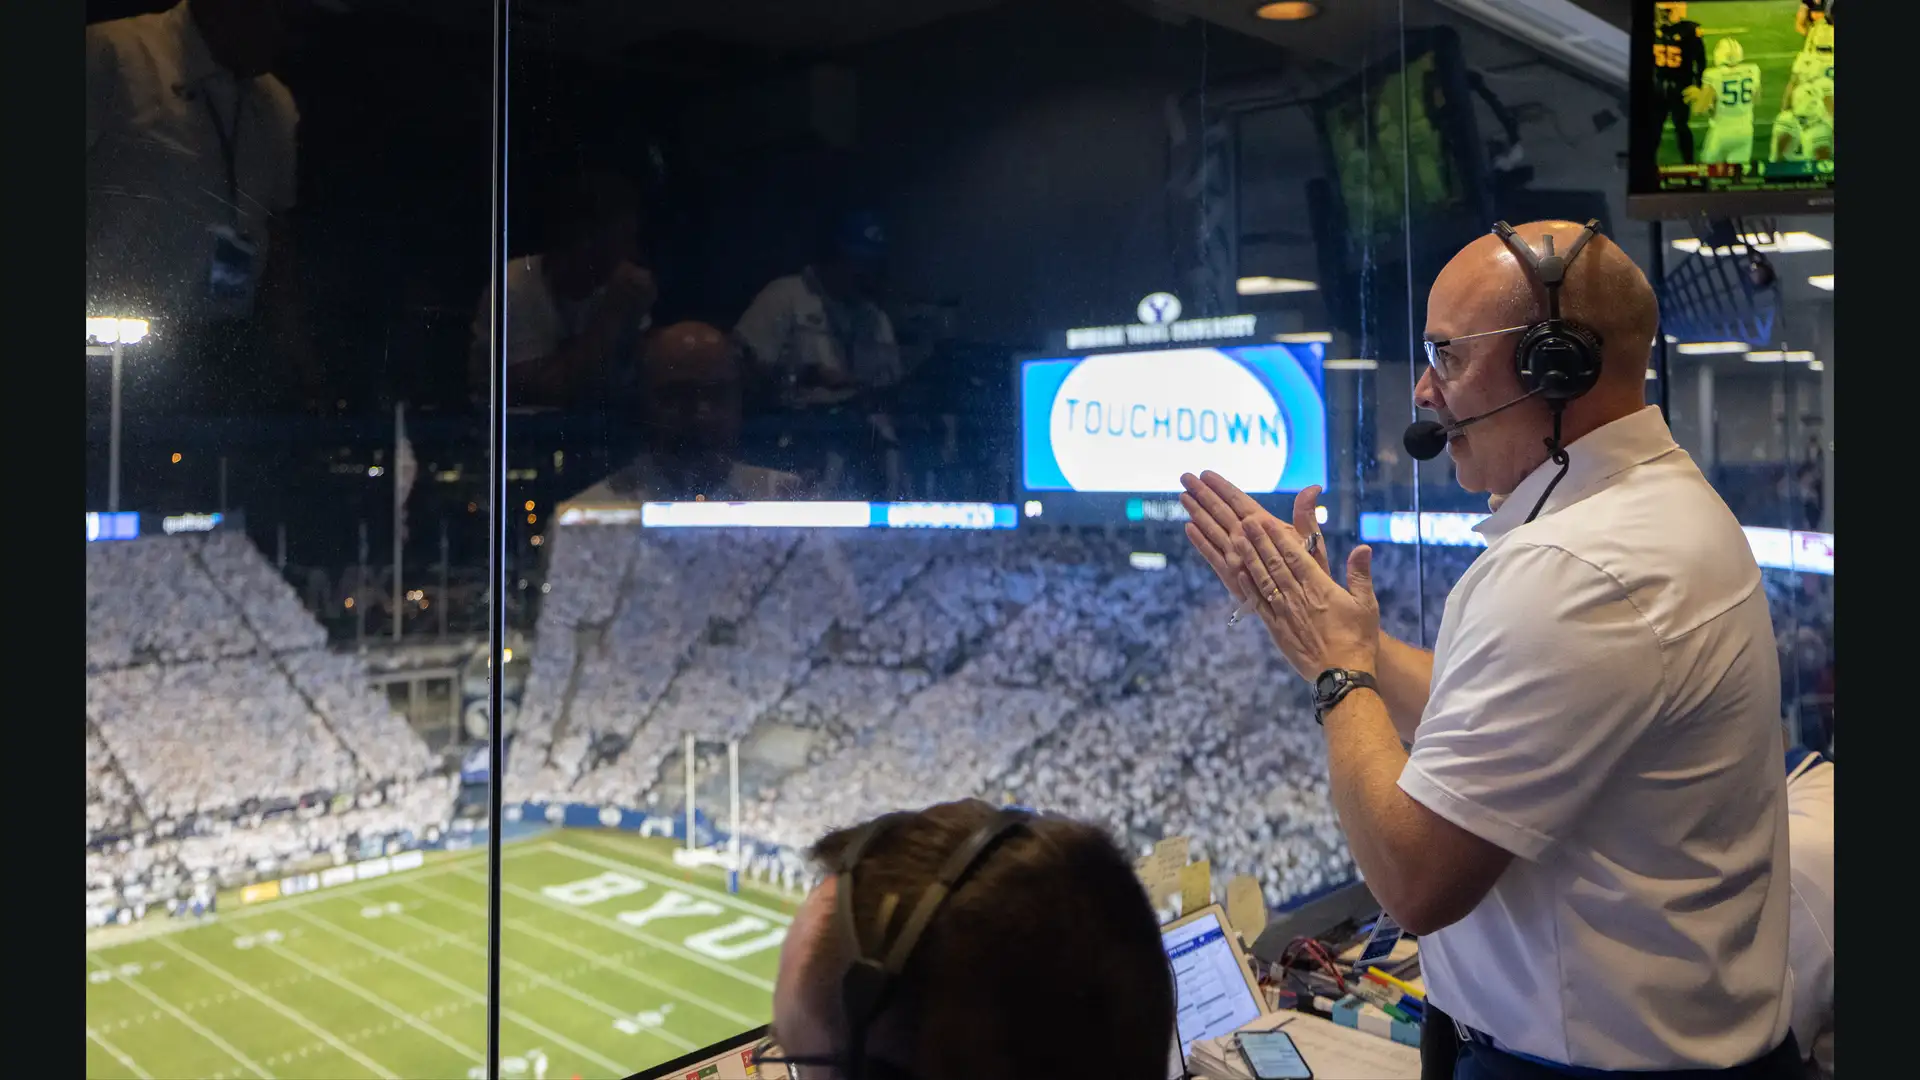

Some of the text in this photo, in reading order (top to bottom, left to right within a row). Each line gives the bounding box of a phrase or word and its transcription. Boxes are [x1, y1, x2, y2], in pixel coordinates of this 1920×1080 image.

[1722, 78, 1752, 105] 56
[1066, 398, 1281, 448] TOUCHDOWN
[542, 872, 786, 960] BYU
